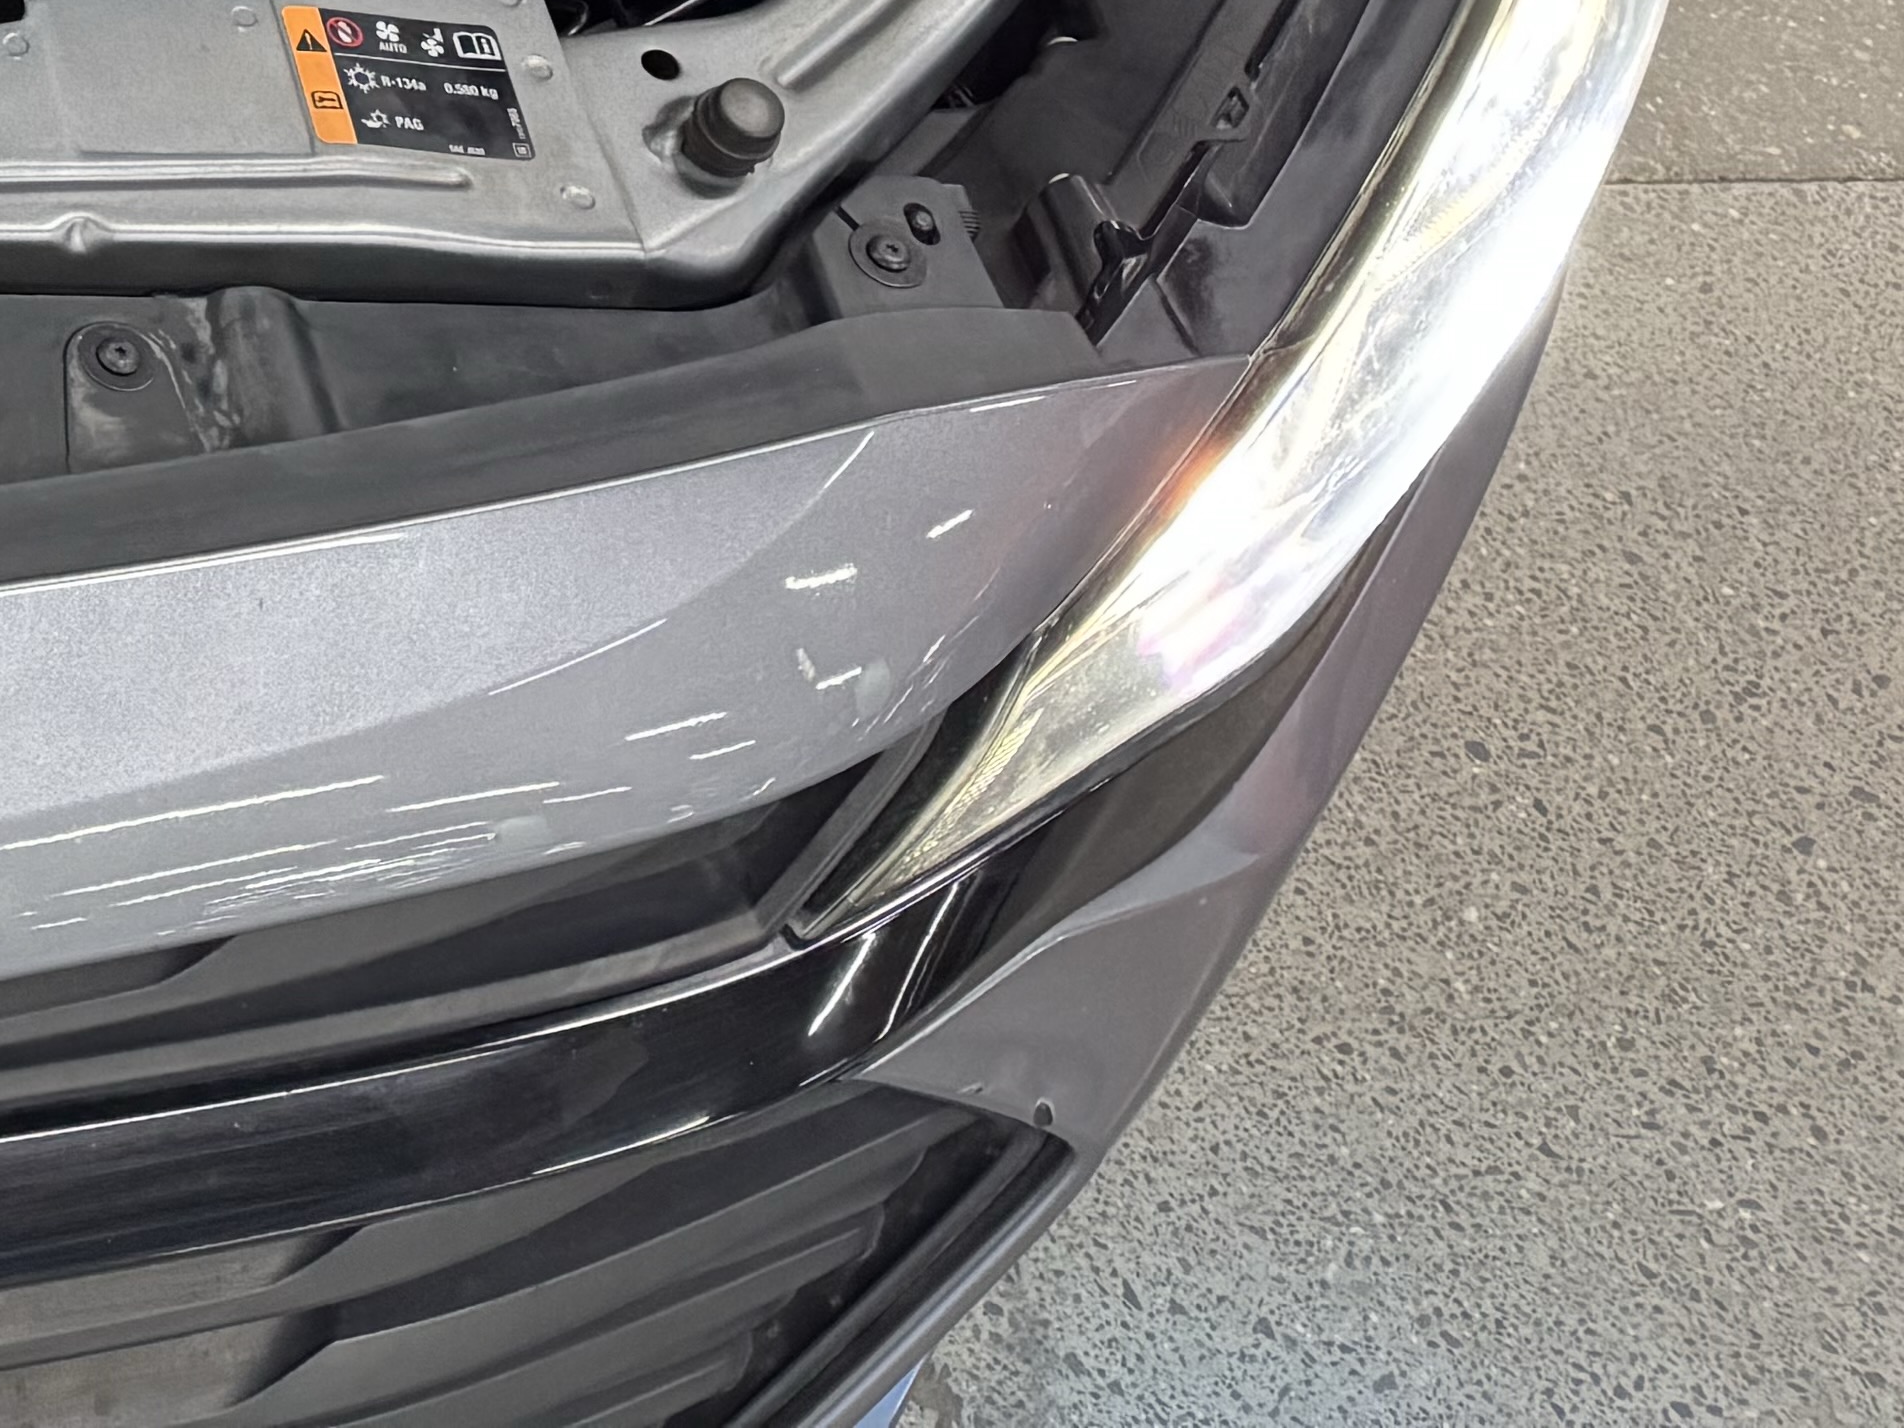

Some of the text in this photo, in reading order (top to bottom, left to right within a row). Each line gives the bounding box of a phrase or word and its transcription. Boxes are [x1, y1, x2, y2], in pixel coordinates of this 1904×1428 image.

[379, 42, 408, 54] AUTO
[381, 75, 427, 92] R-134a
[480, 85, 500, 101] kg
[395, 115, 424, 132] PAG
